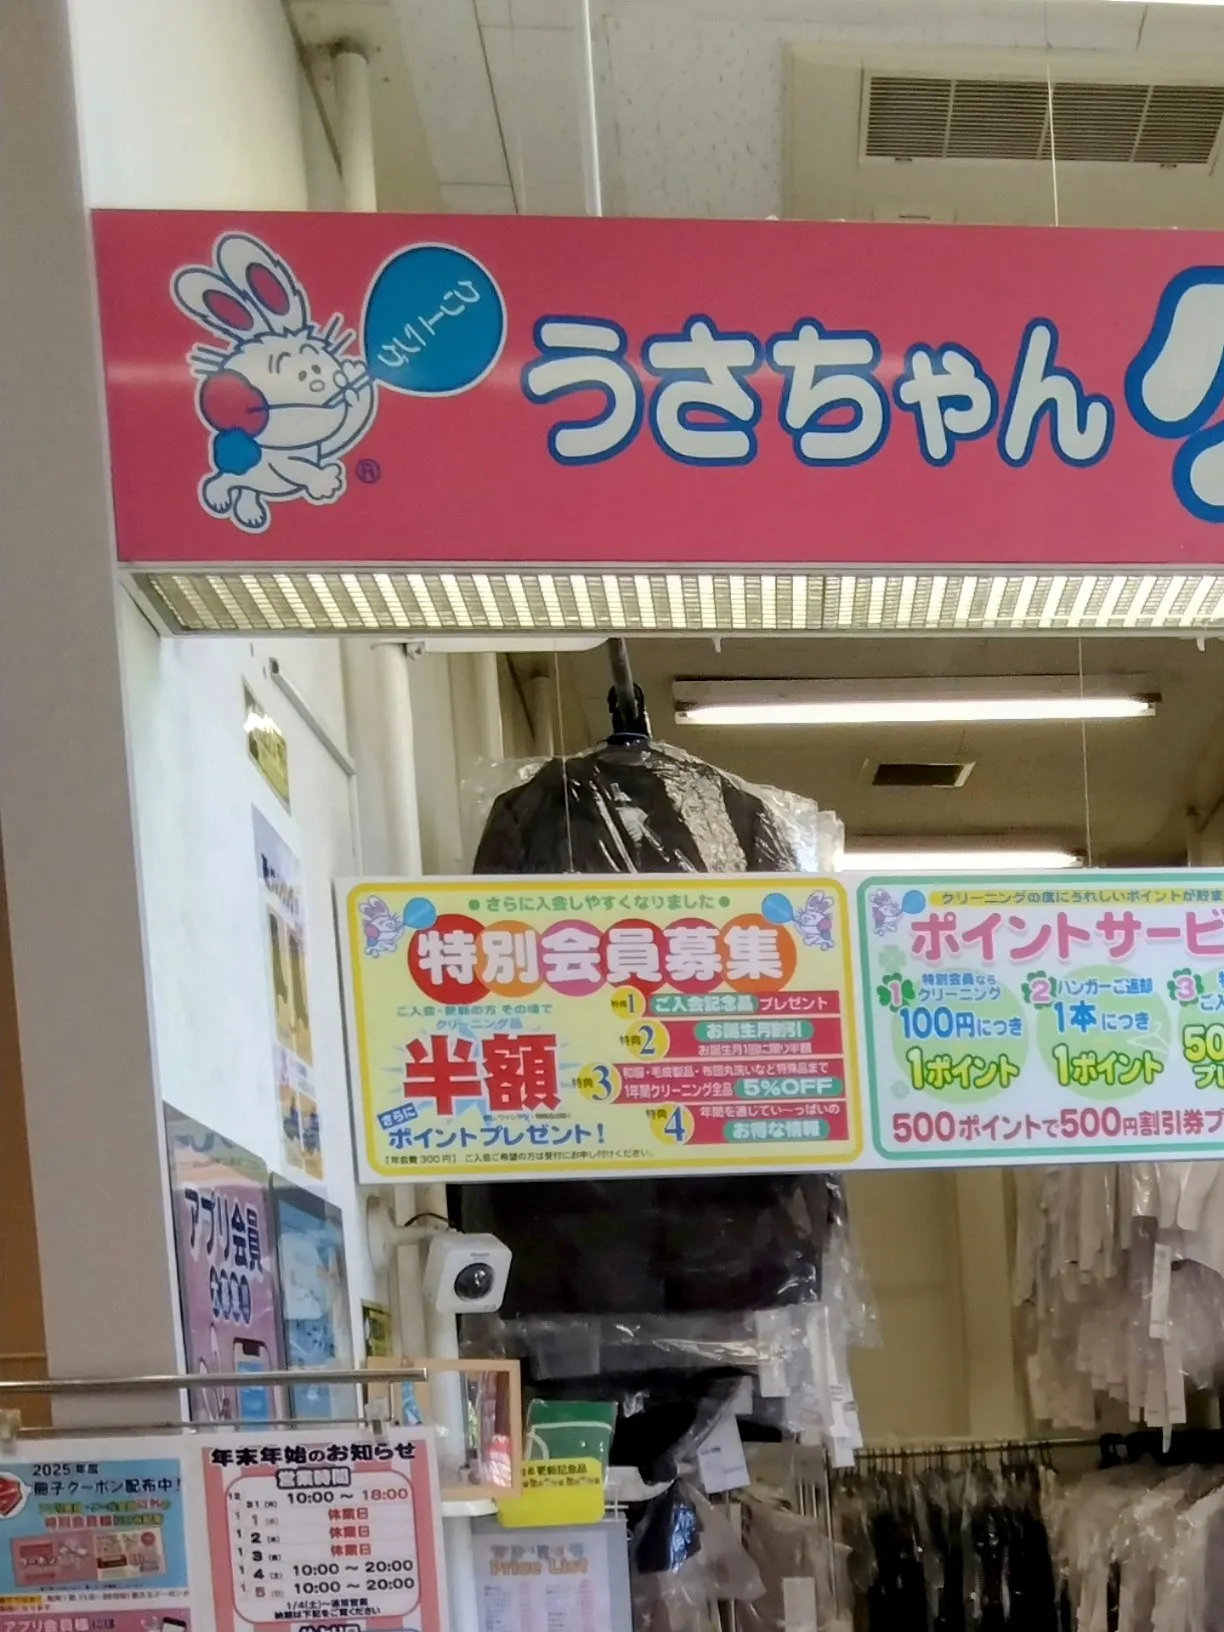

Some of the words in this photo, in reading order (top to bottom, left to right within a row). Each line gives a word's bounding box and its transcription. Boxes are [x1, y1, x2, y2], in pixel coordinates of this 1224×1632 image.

[486, 894, 715, 914] さらに入会しやすくなりました
[418, 925, 786, 984] 特別会員募集
[922, 972, 996, 987] 特別会員なら
[1058, 977, 1154, 997] ハンガーご返却
[918, 985, 1001, 1002] クリーニング
[900, 1006, 1023, 1040] 100円につき
[403, 1034, 562, 1116] 半額
[905, 1045, 1021, 1091] 1ポイント
[1053, 1043, 1164, 1087] 1ポイント
[379, 1105, 417, 1127] さらに
[732, 1119, 821, 1139] お得な情報
[184, 1187, 265, 1273] アプリ会員
[210, 1443, 416, 1468] 年末年始のお知らせ
[276, 1467, 351, 1490] 営業時間
[287, 1491, 335, 1505] 10:00
[361, 1488, 409, 1501] 18:00
[292, 1563, 340, 1577] 10:00
[364, 1559, 414, 1574] 20:00
[294, 1581, 341, 1594] 10:00
[366, 1577, 415, 1591] 20:00
